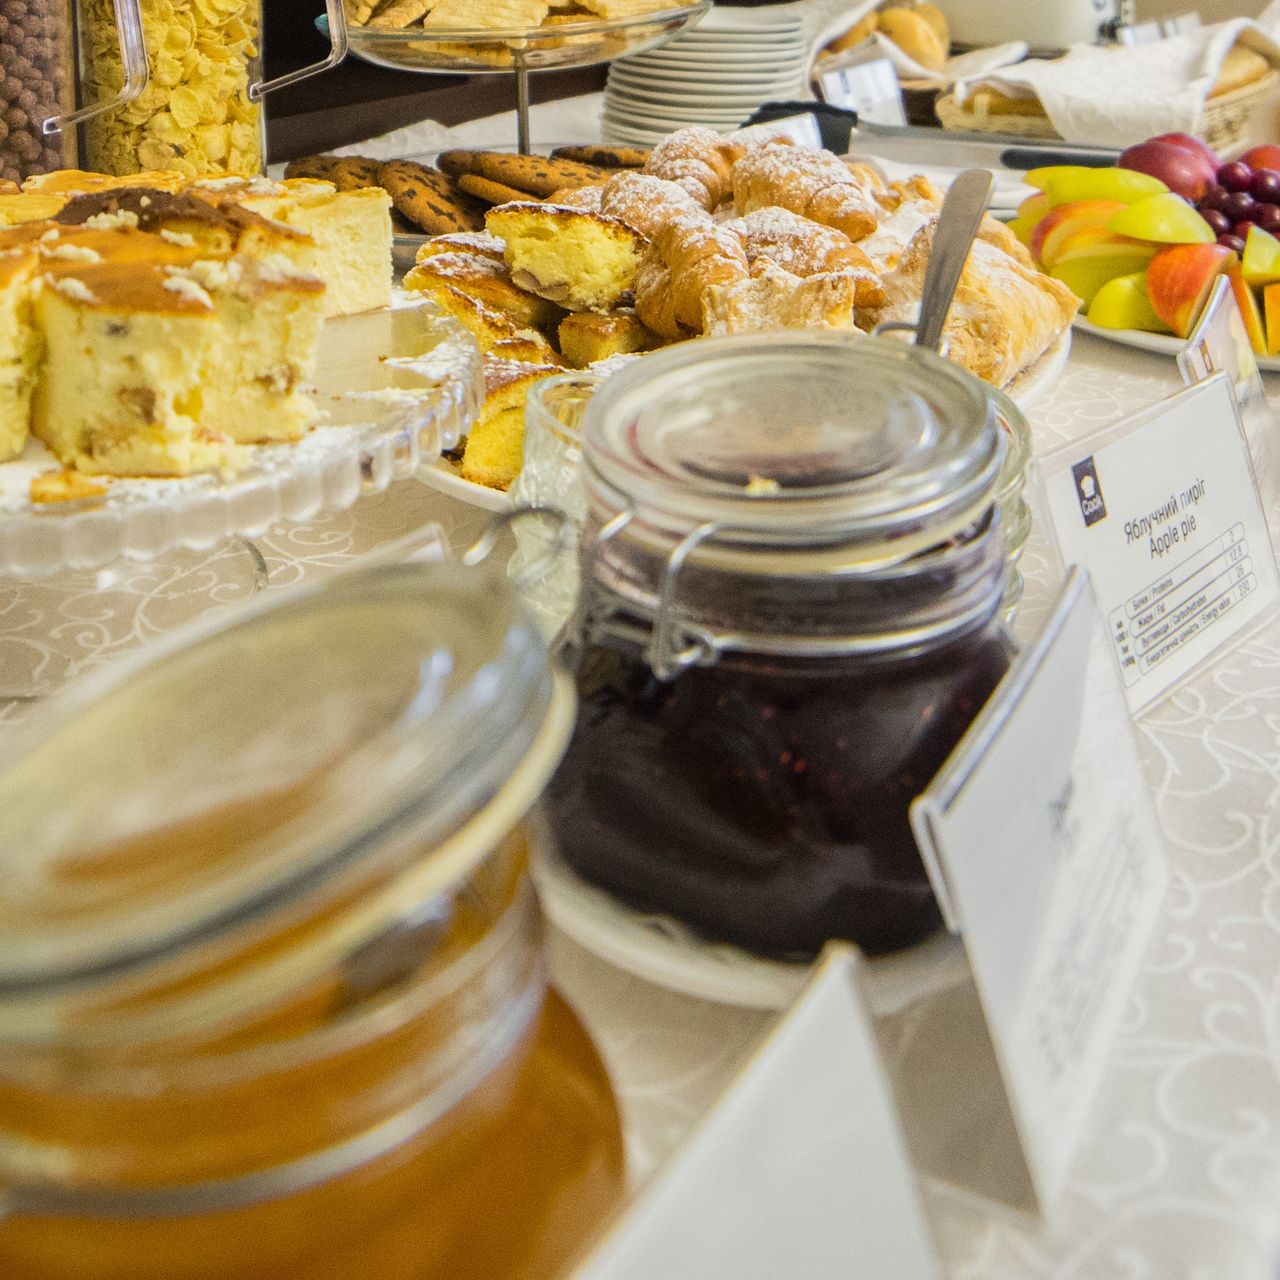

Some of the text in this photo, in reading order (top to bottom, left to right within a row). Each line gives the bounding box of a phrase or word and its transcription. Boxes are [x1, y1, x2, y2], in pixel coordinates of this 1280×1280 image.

[1082, 494, 1104, 516] Cook
[1123, 478, 1205, 544] Яблучний пиріг
[1149, 514, 1197, 559] Apple pie
